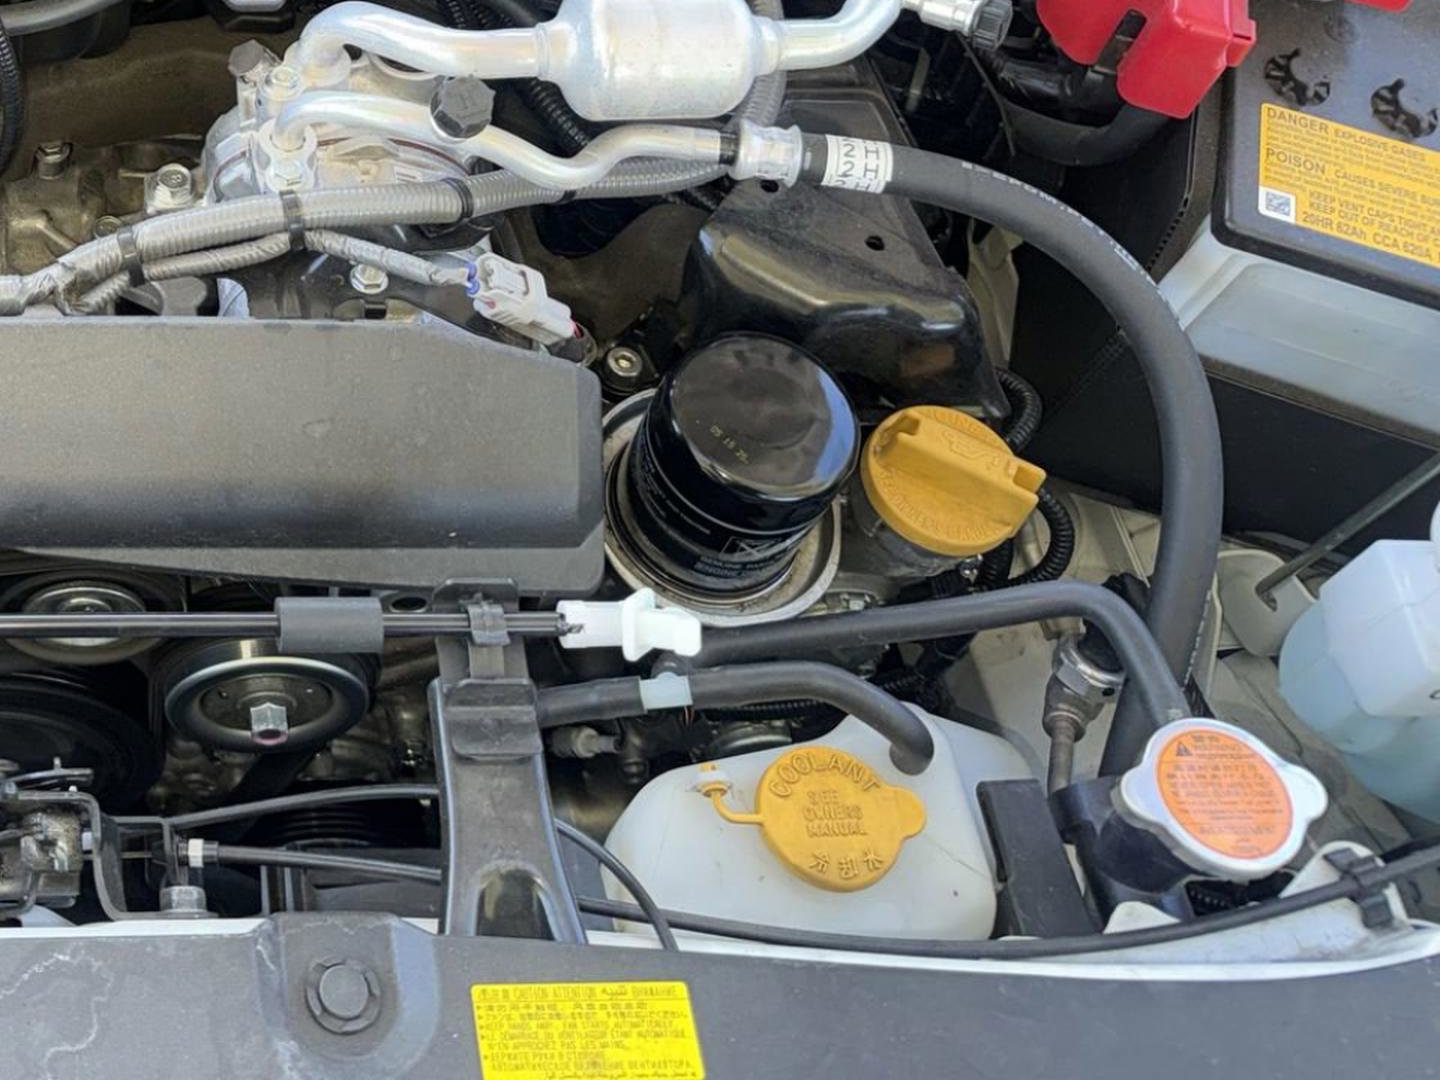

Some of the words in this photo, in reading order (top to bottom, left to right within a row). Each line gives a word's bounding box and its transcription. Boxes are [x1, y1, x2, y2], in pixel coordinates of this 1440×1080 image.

[1266, 106, 1330, 136] DANGER
[1265, 147, 1327, 175] POISON
[1335, 169, 1375, 188] CAUSES
[1311, 190, 1336, 204] KEEP
[1338, 197, 1365, 213] VENT
[1367, 206, 1395, 223] CAPS
[1398, 215, 1427, 231] TIGHT
[1311, 201, 1336, 216] KEEP
[1338, 209, 1361, 223] OUT
[1363, 216, 1377, 227] OF
[1372, 231, 1405, 251] CCA
[768, 751, 881, 798] COOLANT
[806, 789, 839, 805] SEE
[805, 821, 869, 838] MANUAL
